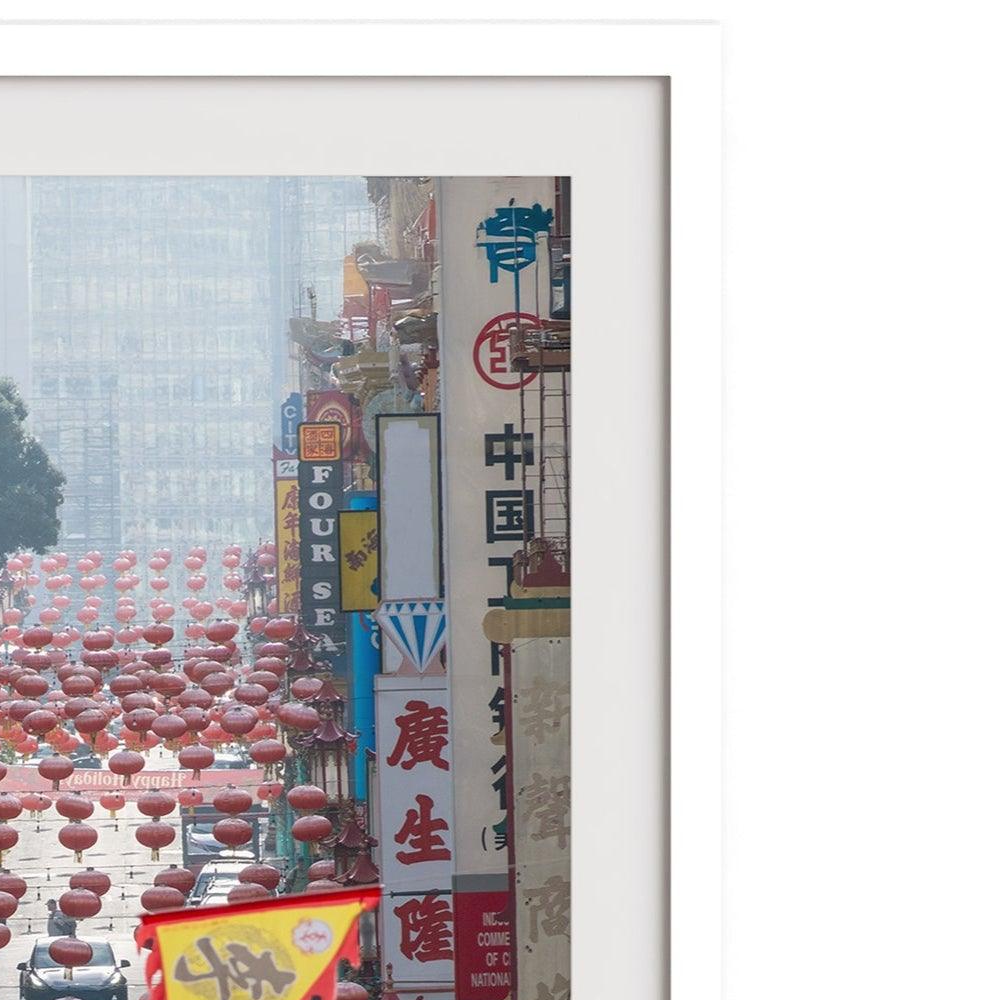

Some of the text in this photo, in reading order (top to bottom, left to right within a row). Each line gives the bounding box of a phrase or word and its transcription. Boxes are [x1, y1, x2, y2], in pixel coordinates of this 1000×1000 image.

[309, 466, 335, 562] FOUR
[478, 933, 510, 946] COMME
[486, 953, 498, 966] OF
[471, 973, 511, 986] NATIONA
